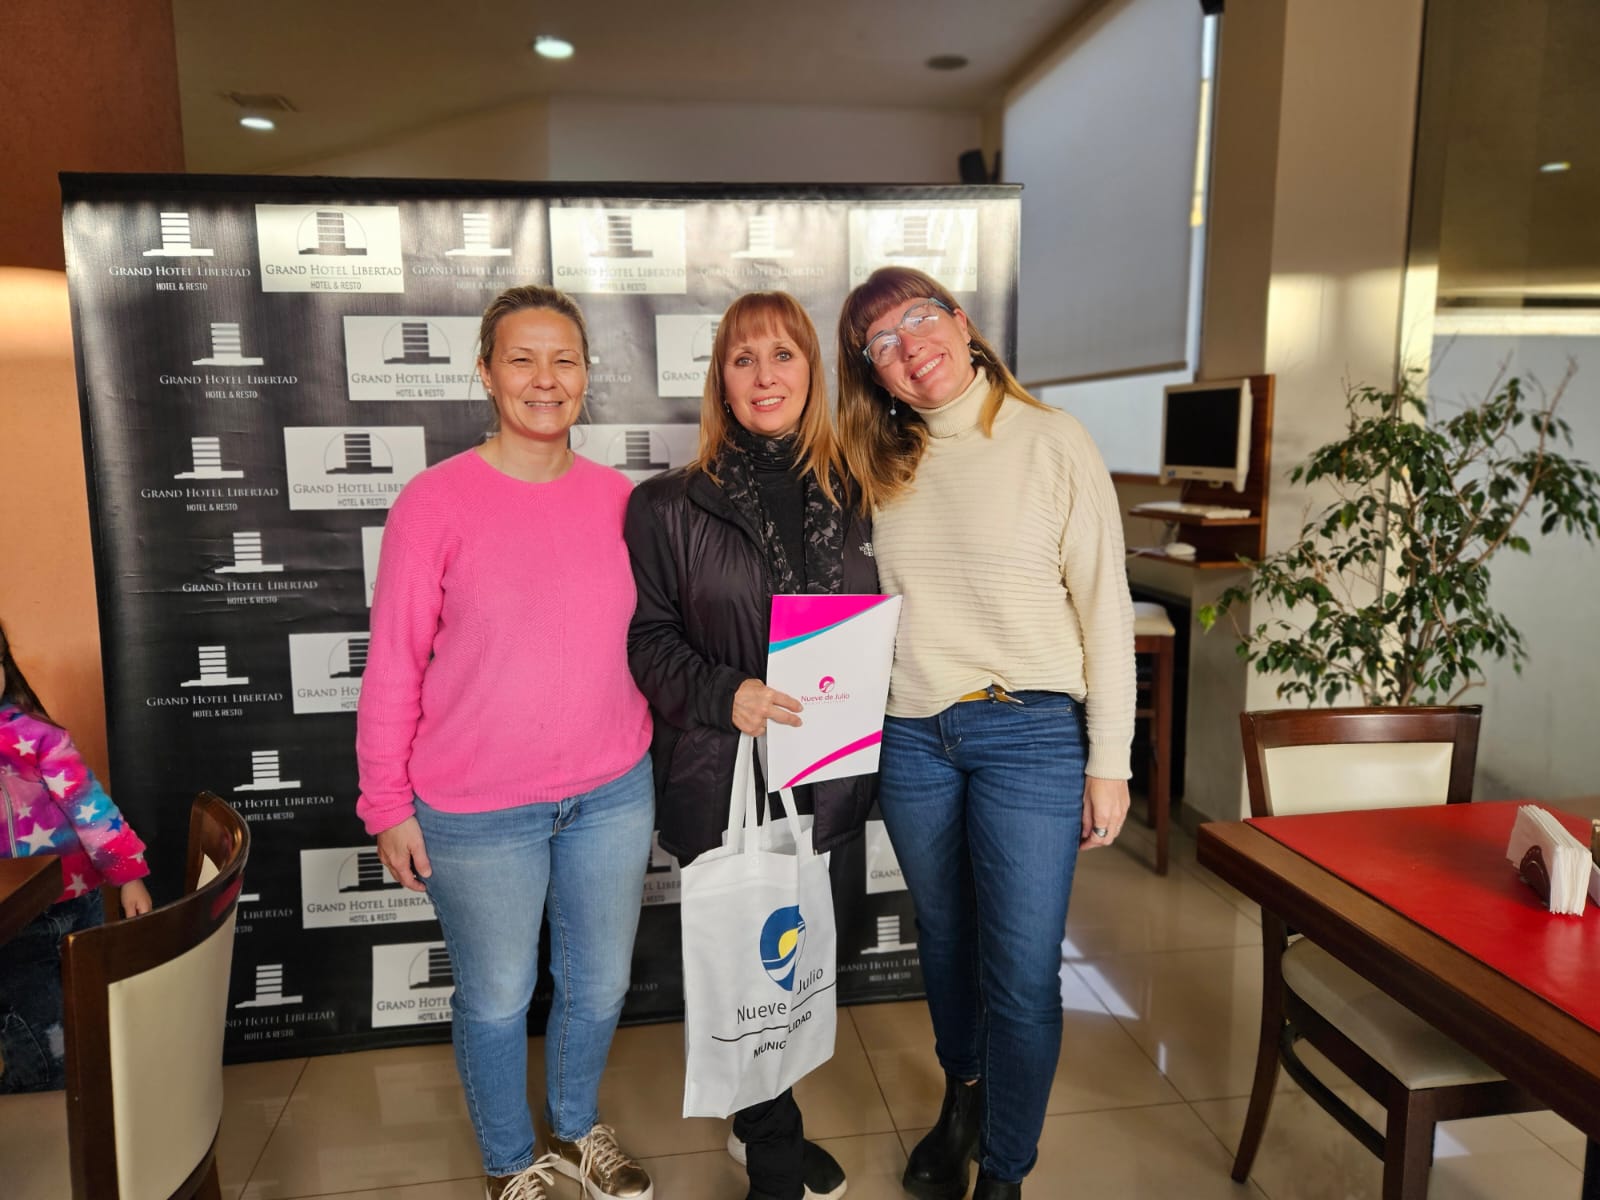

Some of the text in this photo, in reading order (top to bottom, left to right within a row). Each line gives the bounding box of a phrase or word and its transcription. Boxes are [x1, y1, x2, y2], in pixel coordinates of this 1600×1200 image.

[109, 266, 250, 277] GRAND HOTEL LIBERTAD
[265, 264, 401, 276] GRAND HOTEL LIBERTAD
[311, 281, 332, 289] HOTEL
[341, 281, 362, 289] RESTO
[159, 375, 298, 384] GRAND HOTEL LIBERTAD
[351, 373, 392, 384] GRAND
[396, 374, 432, 383] HOTEL
[590, 374, 632, 383] IBERTAD
[662, 371, 700, 381] GRAND
[206, 391, 227, 399] HOTEL
[396, 389, 445, 397] HOTEL & RESTO
[141, 488, 278, 498] GRAND HOTEL LIBERTAD
[293, 483, 403, 494] GRAND HOTEL LIBE
[216, 503, 238, 511] RESTO
[337, 498, 387, 506] HOTEL & RESTO
[182, 581, 318, 592] GRAND HOTEL LIBERTAD
[227, 597, 247, 605] HOTEL
[297, 688, 337, 698] GRAND
[825, 693, 833, 701] de
[146, 693, 283, 707] GRAND HOTEL LIBERTAD
[193, 710, 213, 718] HOTEL
[215, 709, 220, 717] &
[245, 799, 281, 808] HOTEL
[285, 796, 334, 806] LIBERTAD
[245, 813, 264, 821] HOTEL
[273, 812, 294, 820] RESTO
[307, 902, 346, 913] GRAND
[350, 900, 384, 910] HOTEL
[243, 909, 293, 919] LIBERTAD
[350, 914, 369, 922] HOTEL
[377, 913, 397, 921] RESTO
[838, 963, 867, 972] RAND
[737, 968, 824, 1024] Nueve Julio
[377, 997, 448, 1011] GRAND HOTE
[245, 1016, 280, 1026] HOTEL
[285, 1011, 335, 1023] LIBERTAD
[418, 1012, 437, 1021] HOTEL
[439, 1012, 444, 1020] &
